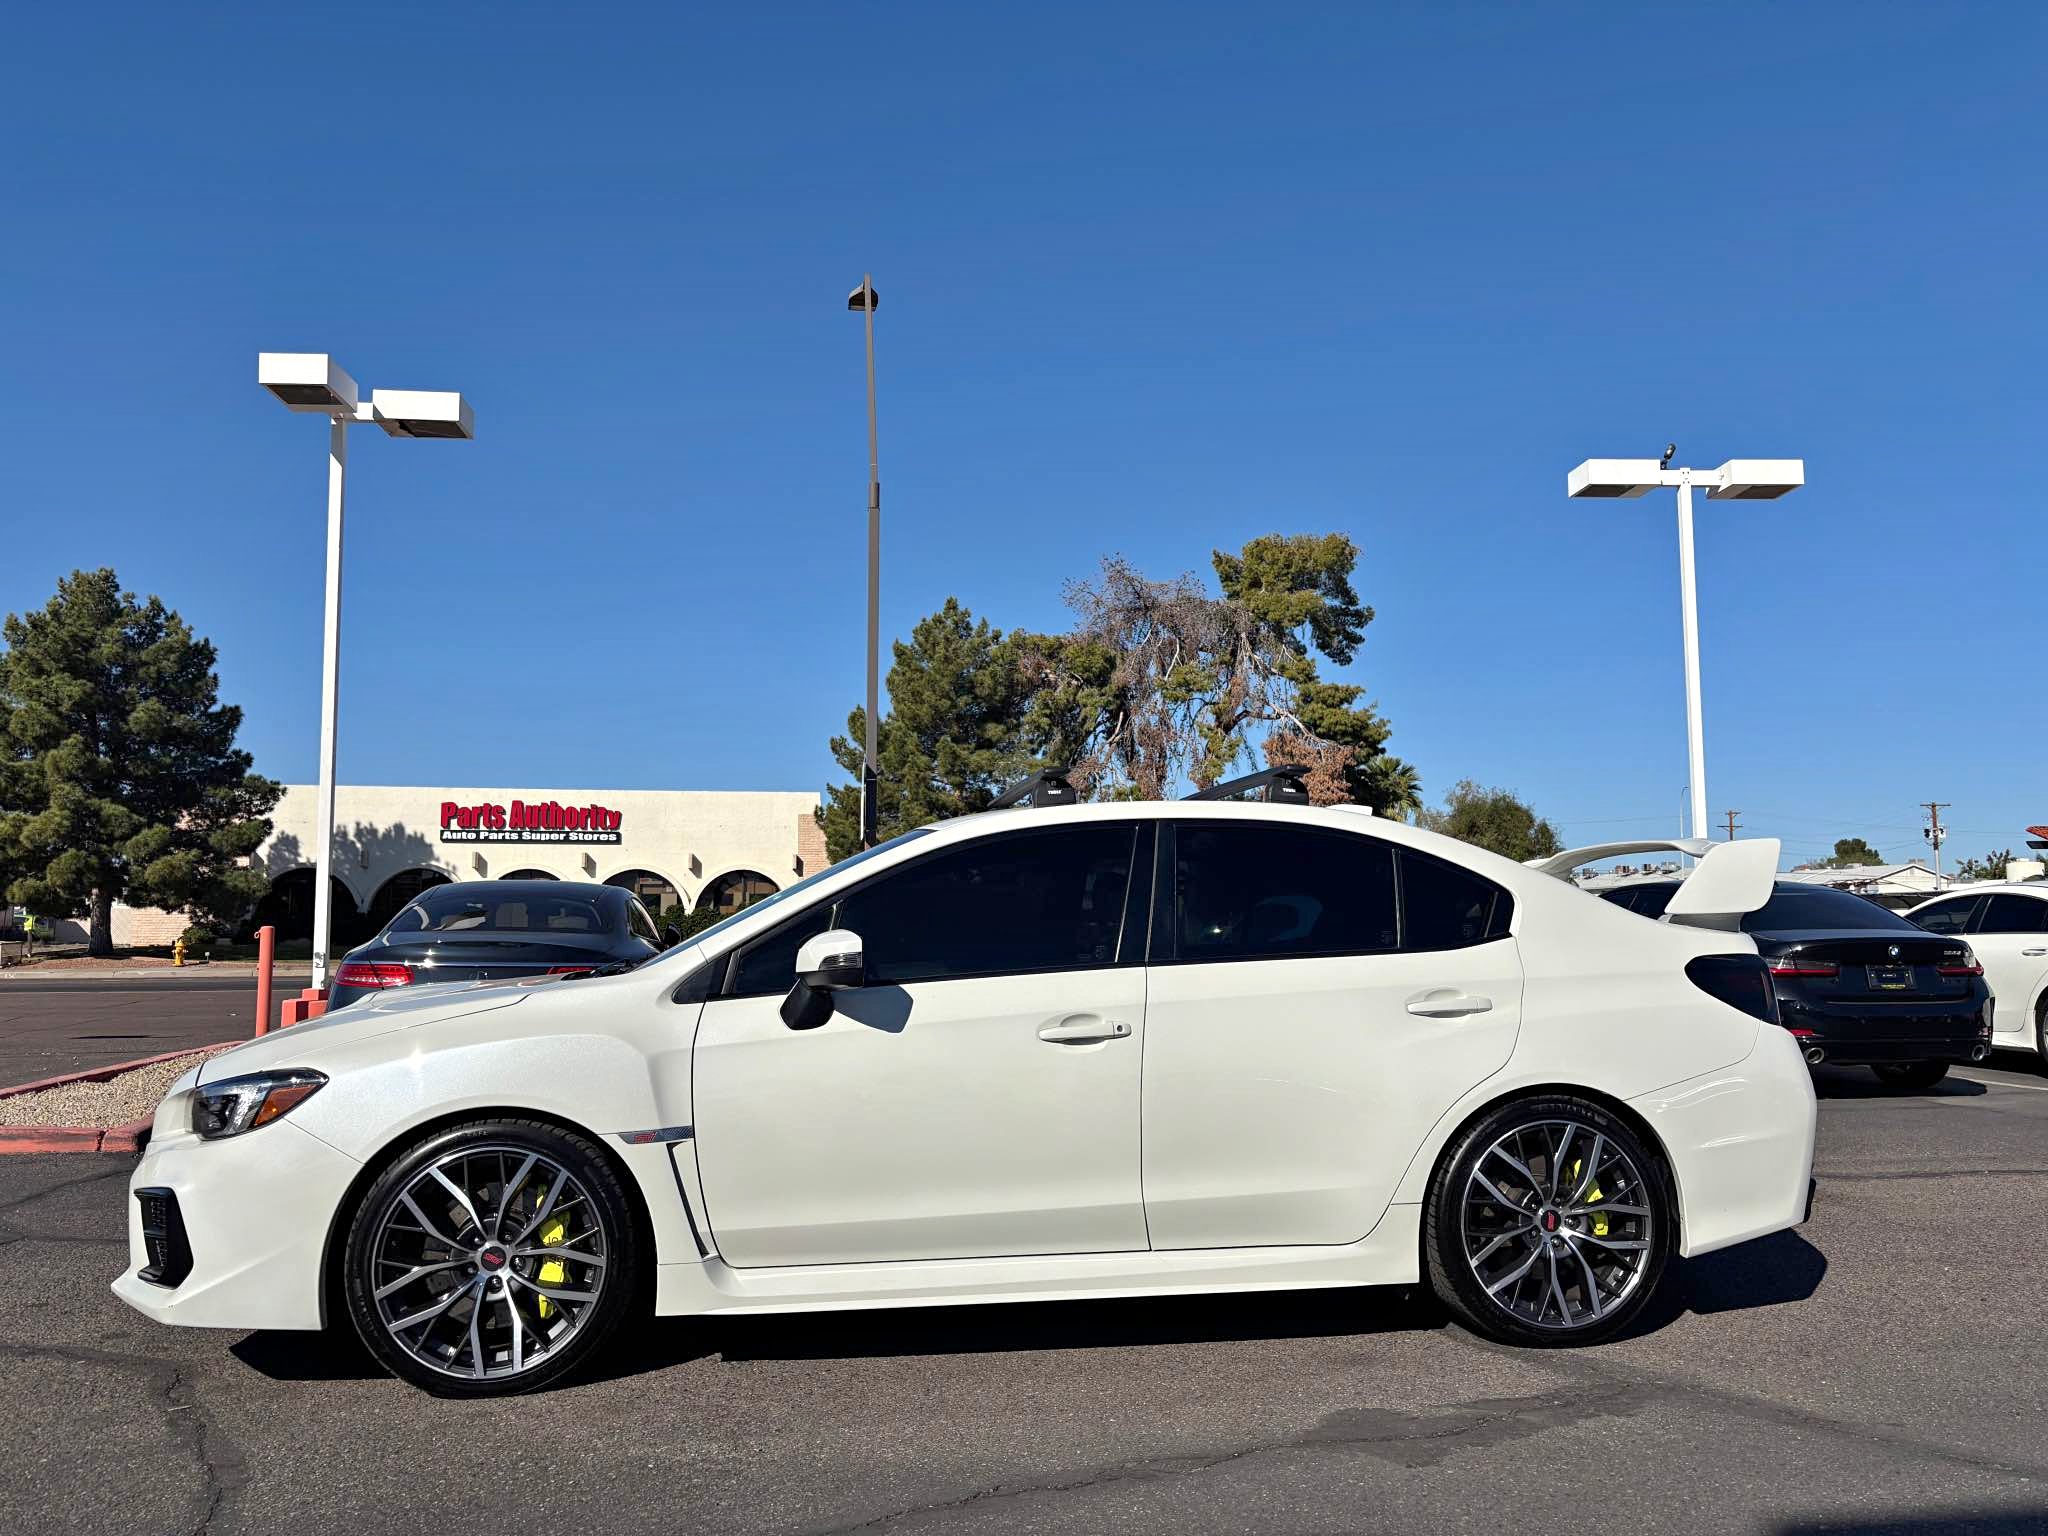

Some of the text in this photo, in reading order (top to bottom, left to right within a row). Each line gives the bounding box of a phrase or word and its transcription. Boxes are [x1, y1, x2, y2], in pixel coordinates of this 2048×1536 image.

[440, 800, 622, 831] Parts Authority
[442, 831, 617, 842] Auto Parts Super Stores
